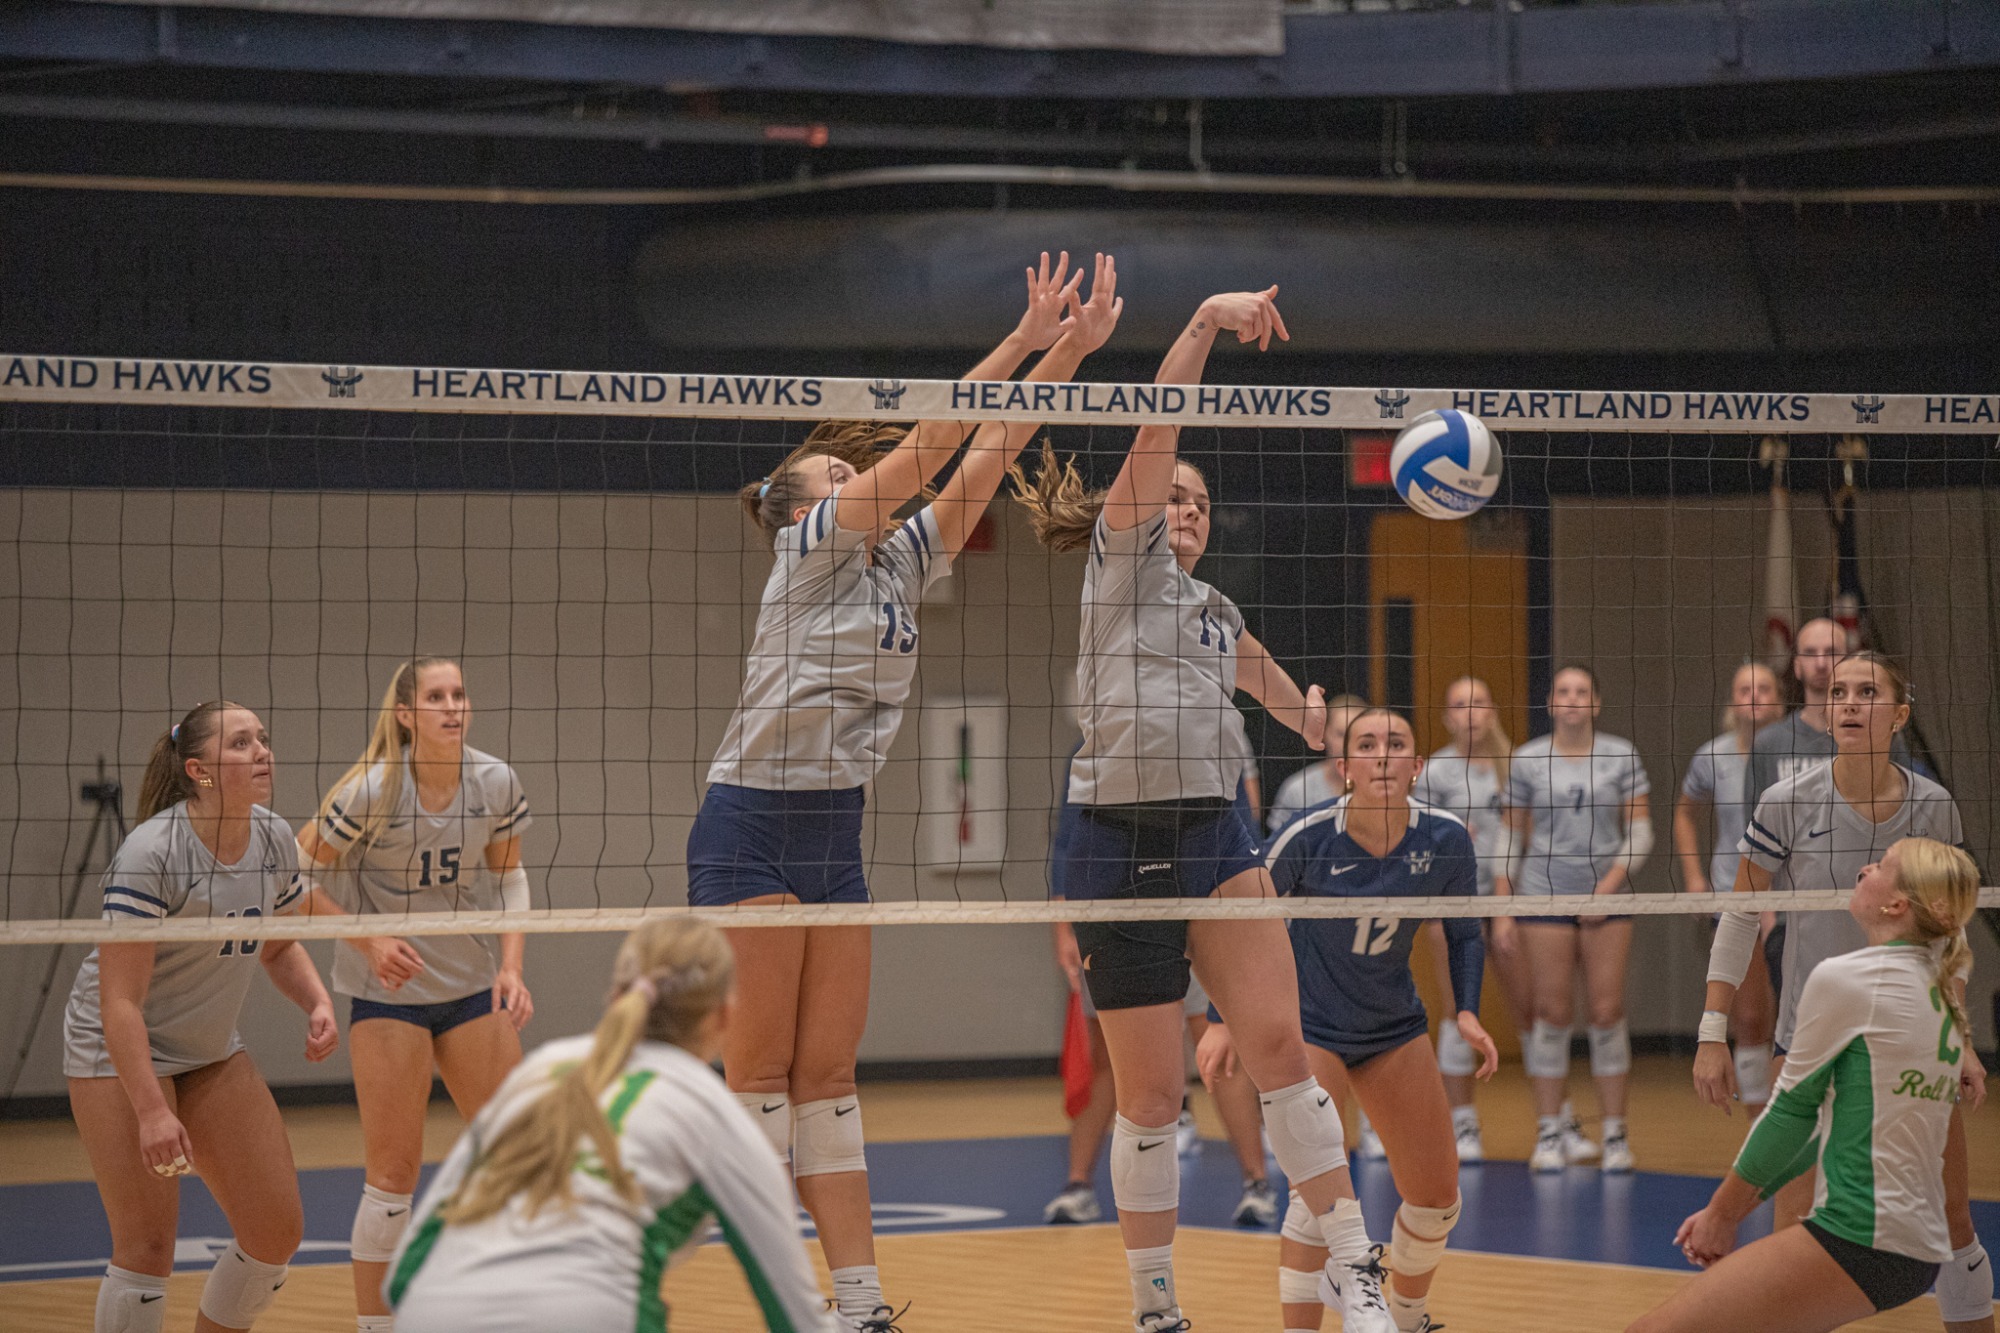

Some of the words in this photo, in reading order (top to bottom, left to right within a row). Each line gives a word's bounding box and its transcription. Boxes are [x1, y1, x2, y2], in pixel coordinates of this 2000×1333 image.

[3, 358, 98, 388] AND
[113, 361, 271, 393] HAWKS
[412, 369, 666, 403] HEARTLAND
[679, 376, 822, 406] HAWKS
[951, 382, 1185, 413] HEARTLAND
[1197, 387, 1331, 416] HAWKS
[1452, 391, 1672, 419] HEARTLAND
[1683, 394, 1810, 421] HAWKS
[1924, 397, 2000, 423] HEA
[419, 847, 460, 887] 15
[1351, 917, 1400, 956] 12
